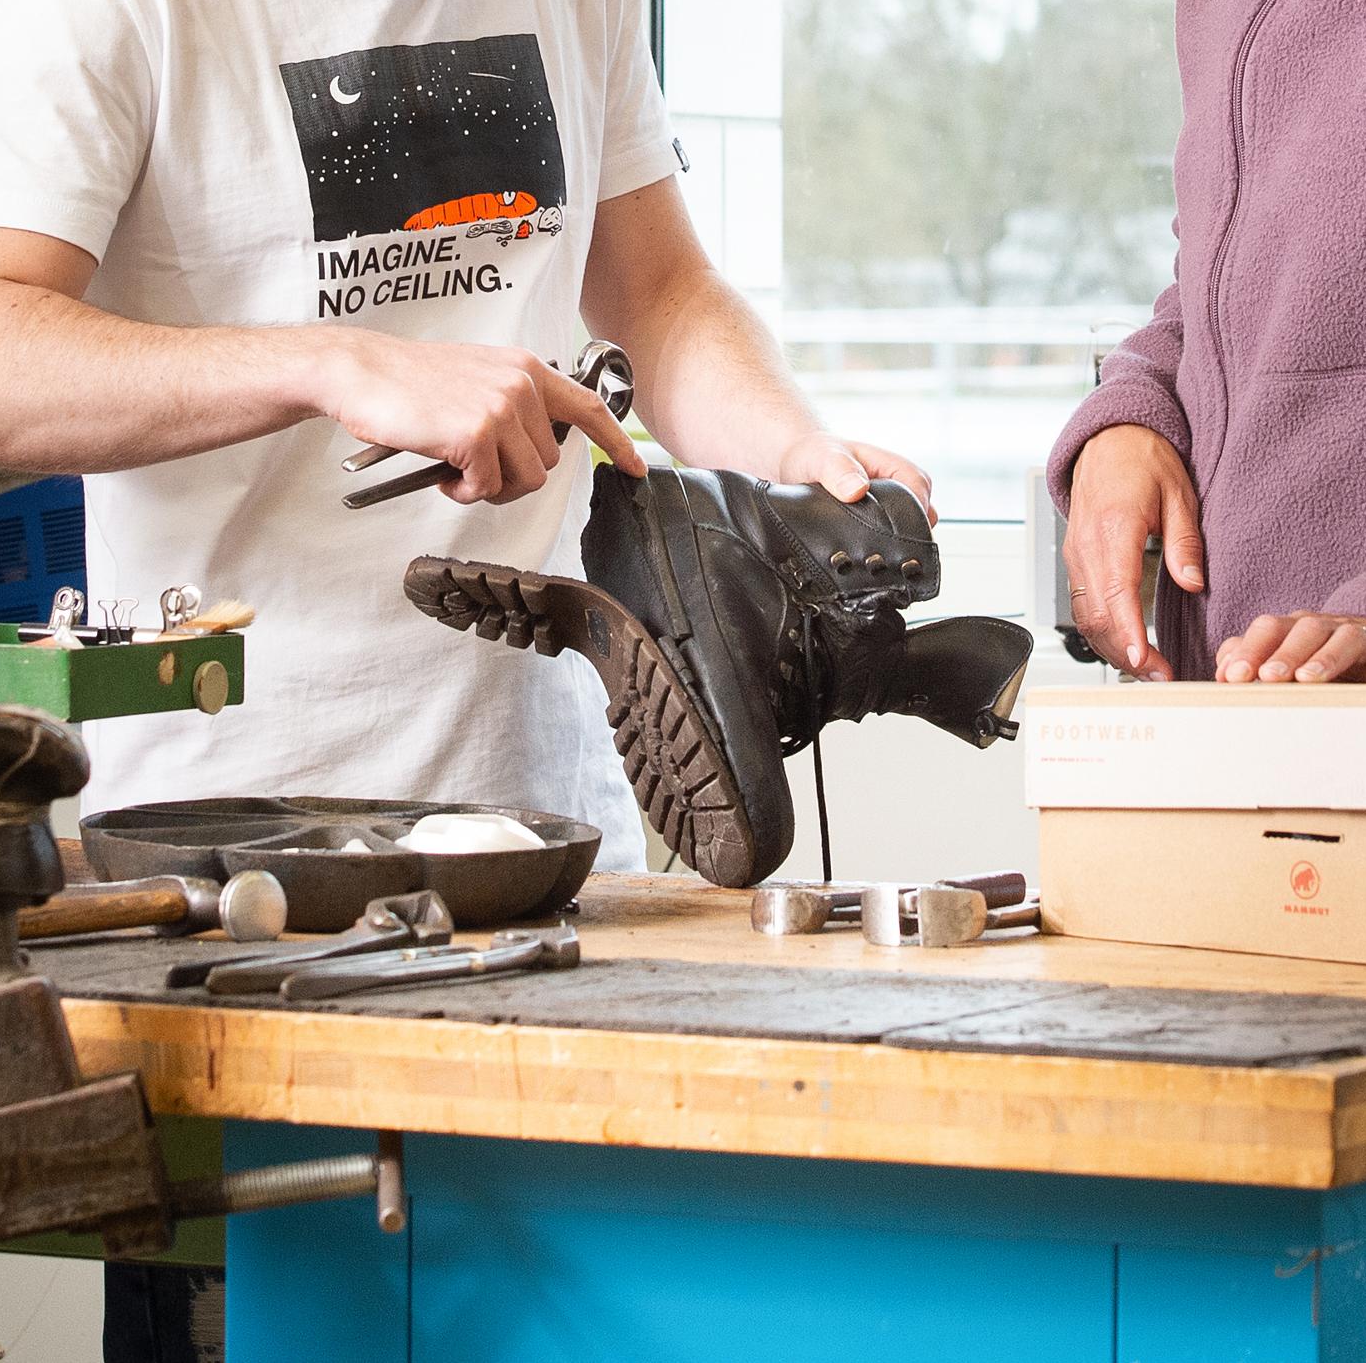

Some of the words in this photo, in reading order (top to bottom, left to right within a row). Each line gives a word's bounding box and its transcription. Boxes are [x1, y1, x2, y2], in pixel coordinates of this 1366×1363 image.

[317, 236, 461, 280] IMAGINE.
[318, 285, 366, 318] NO
[372, 264, 513, 306] CEILING.
[1040, 724, 1156, 741] FOOTWEAR
[1284, 904, 1330, 915] MAMMUT
